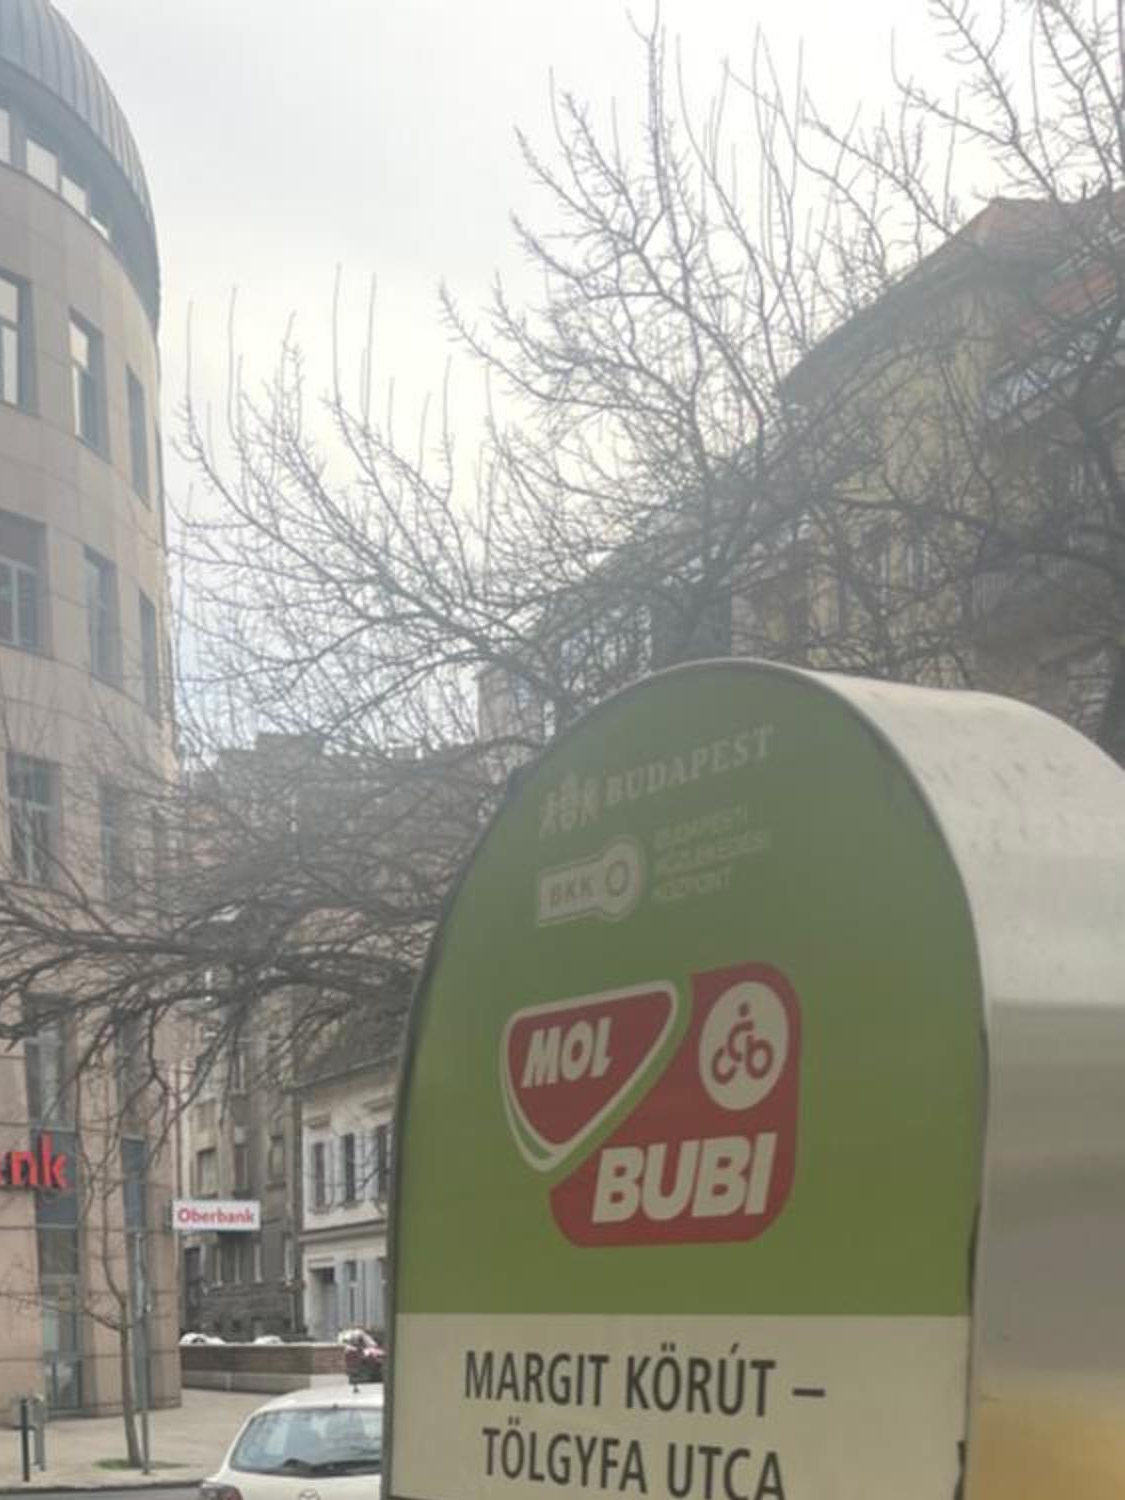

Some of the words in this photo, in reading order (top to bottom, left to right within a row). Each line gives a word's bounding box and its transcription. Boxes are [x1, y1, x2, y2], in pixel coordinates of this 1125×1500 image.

[604, 724, 775, 807] BUDAPEST
[549, 874, 594, 908] BKK
[520, 1015, 612, 1089] MOL
[178, 1207, 255, 1223] Oberbank
[591, 1131, 778, 1223] BUBI
[464, 1349, 610, 1407] MARGIT
[625, 1342, 777, 1418] KÖRÚT
[481, 1416, 648, 1494] TÖLGYFA
